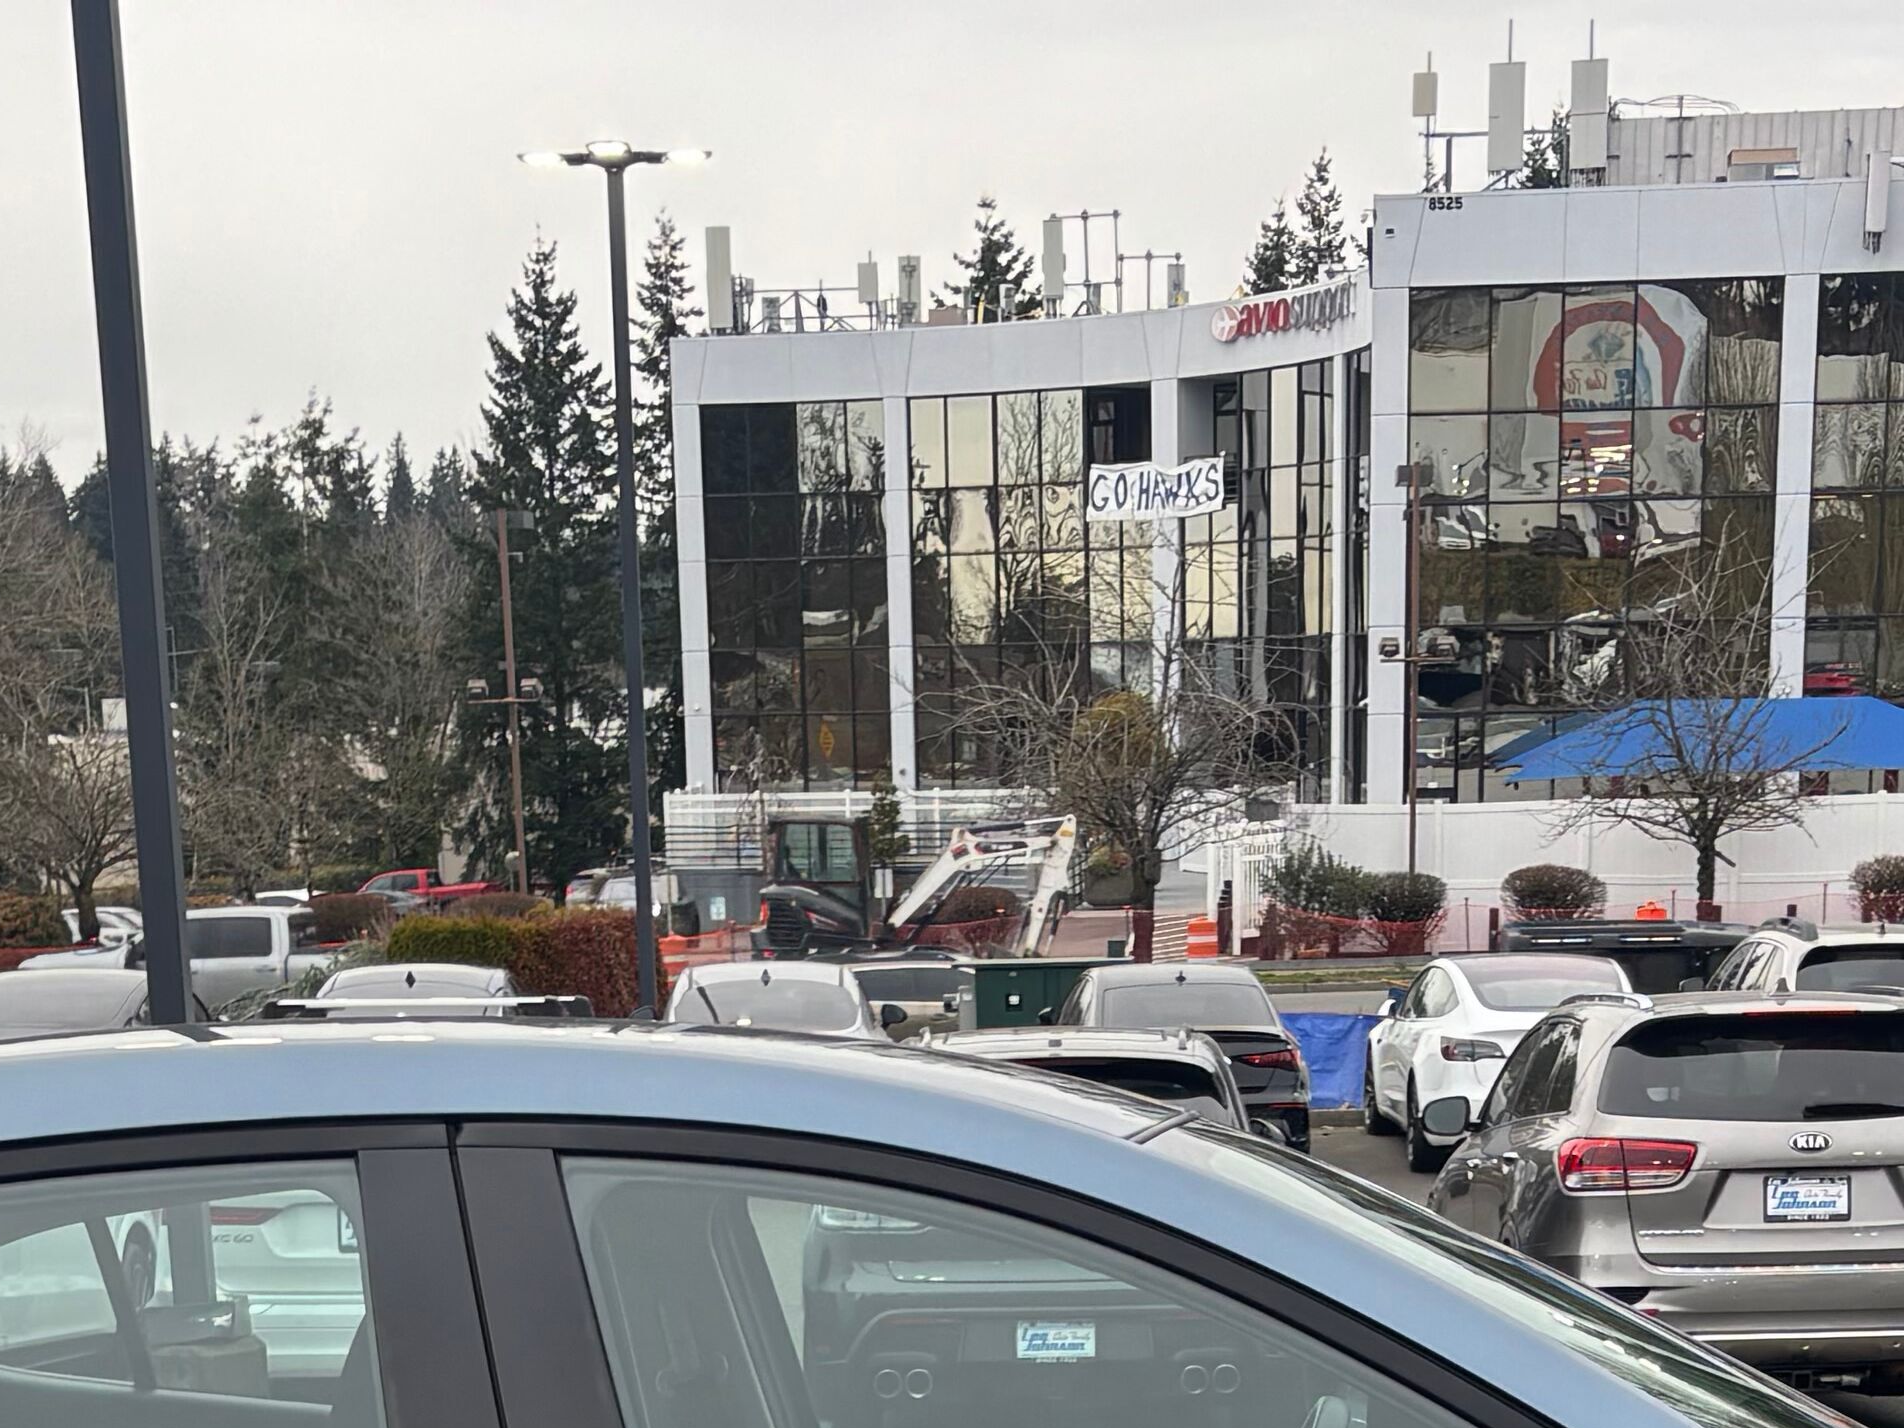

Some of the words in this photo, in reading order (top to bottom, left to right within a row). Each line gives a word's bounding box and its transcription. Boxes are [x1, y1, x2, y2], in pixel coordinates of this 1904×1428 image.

[1428, 196, 1463, 211] 8525
[1091, 473, 1129, 512] GO
[1136, 463, 1219, 511] HAWKS
[1796, 1135, 1826, 1149] KIA
[1771, 1198, 1837, 1209] Johnson
